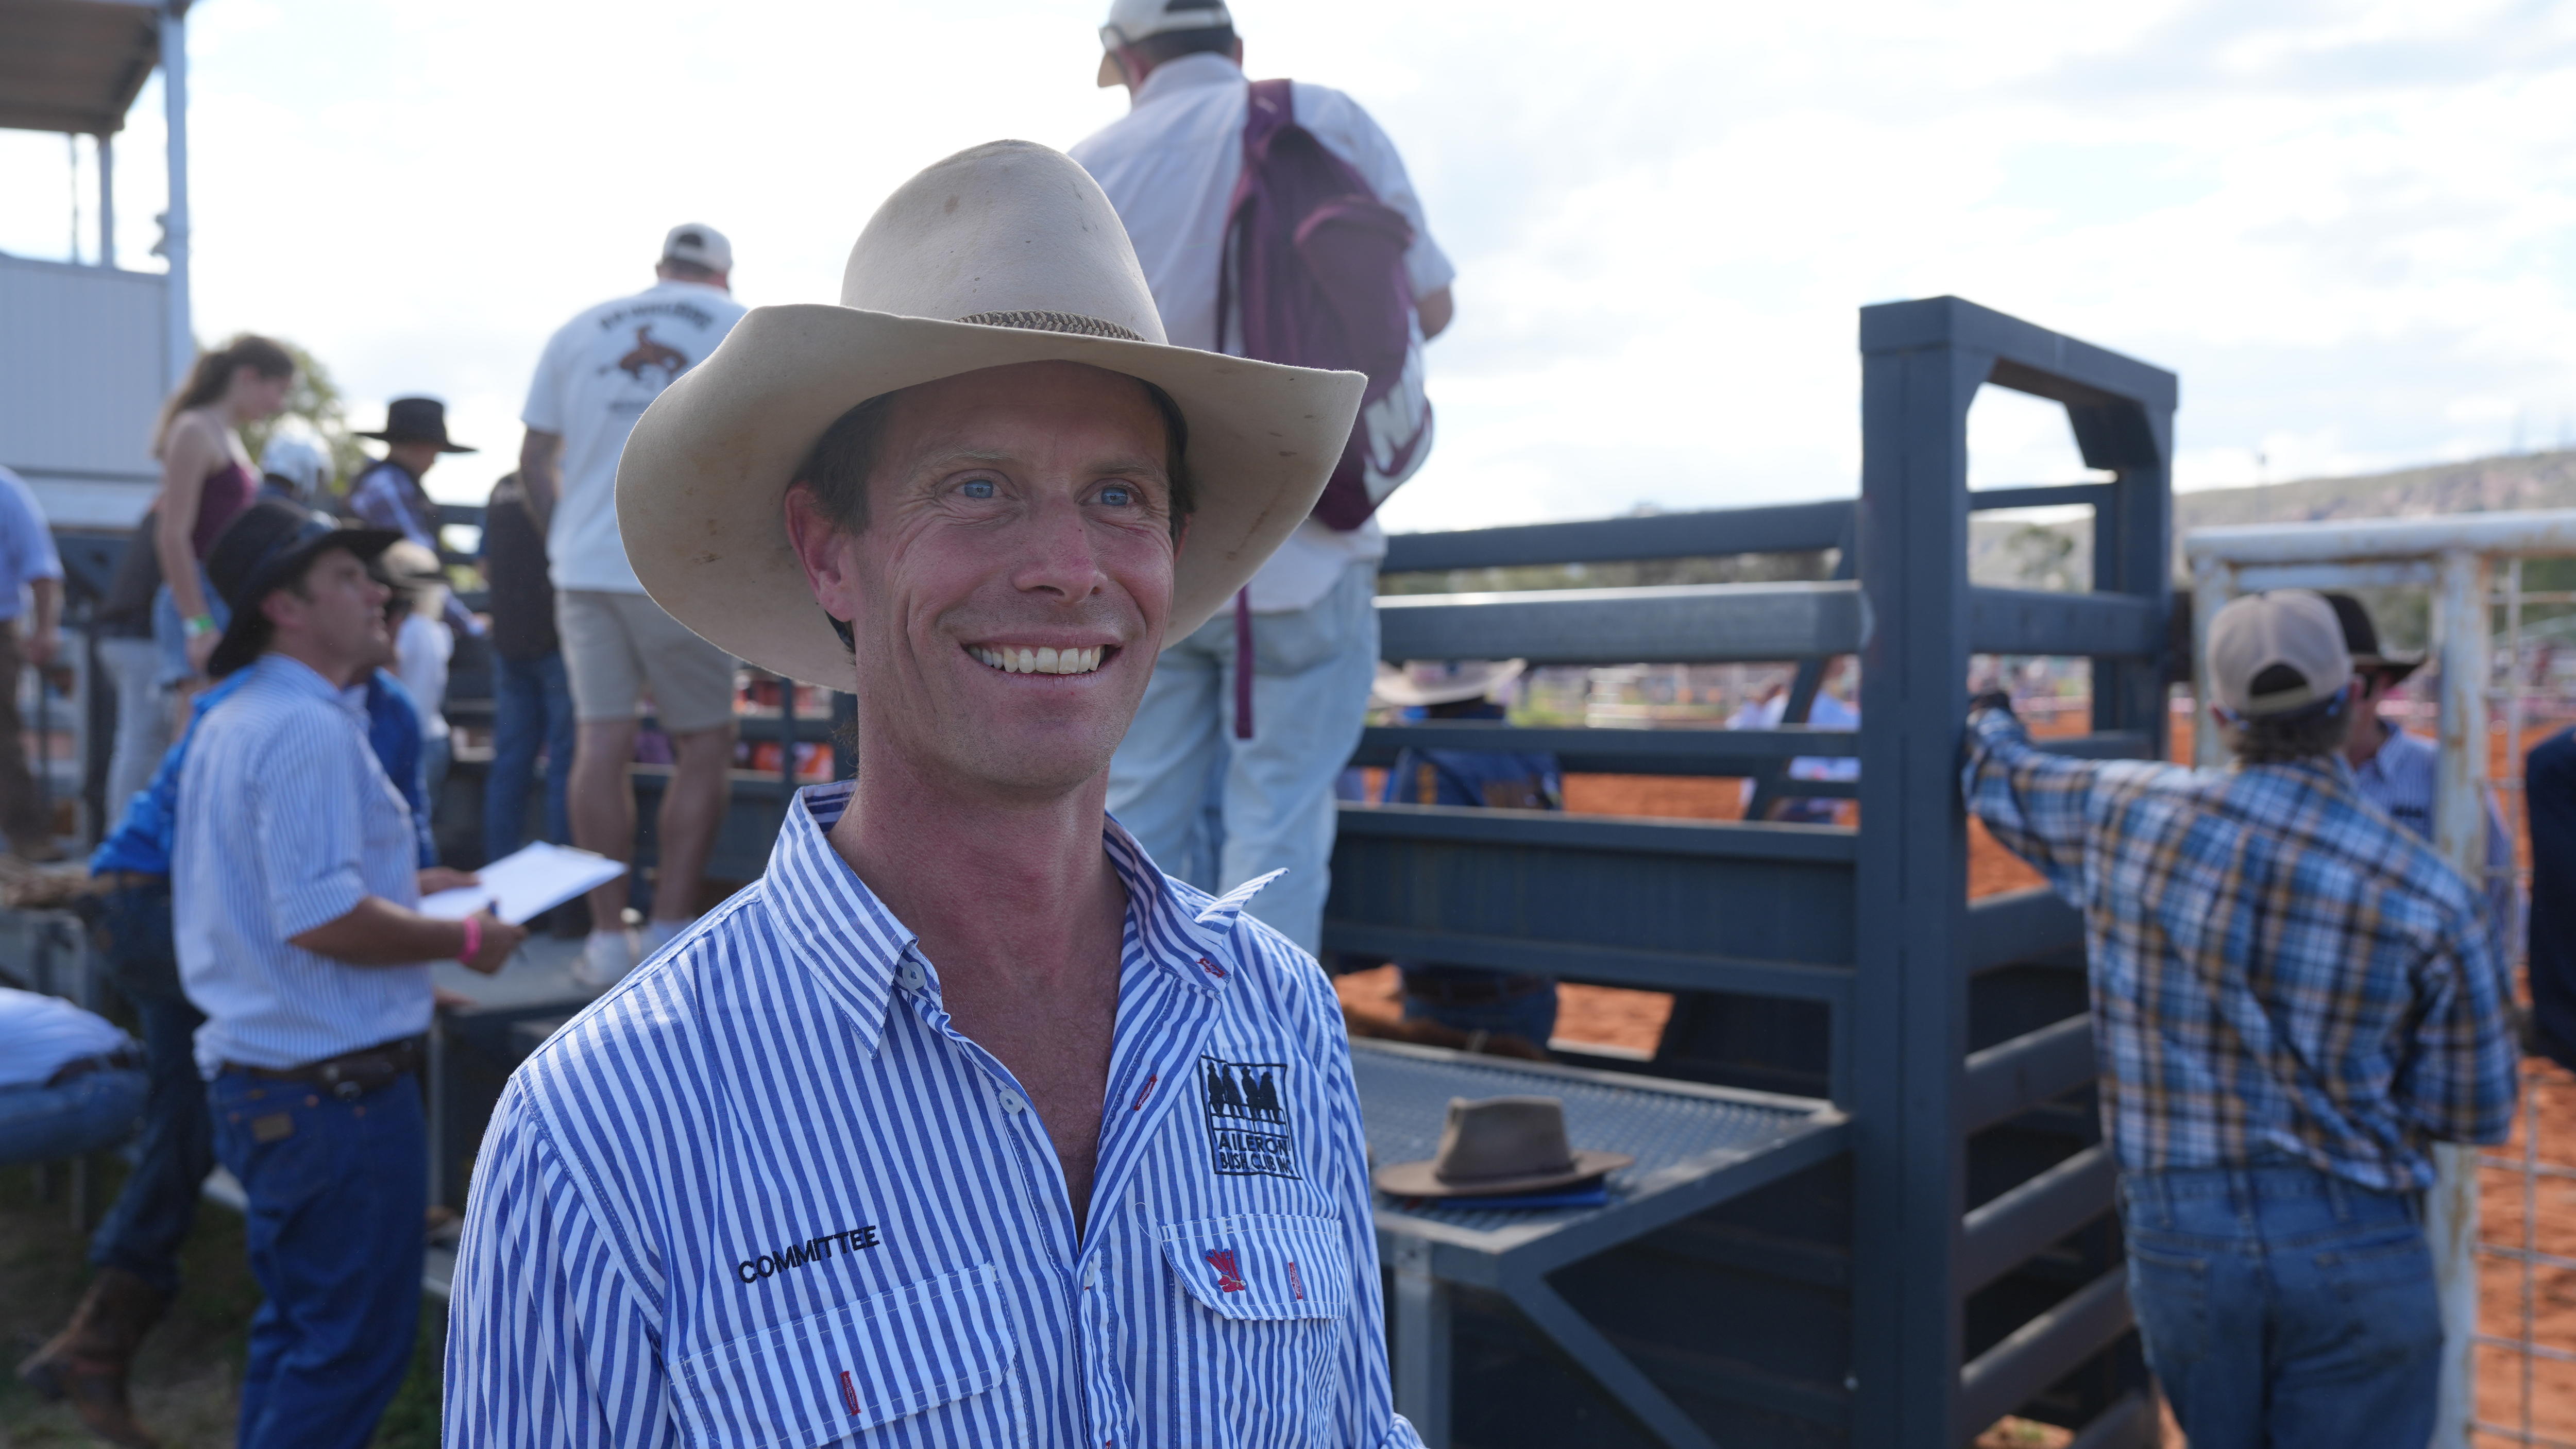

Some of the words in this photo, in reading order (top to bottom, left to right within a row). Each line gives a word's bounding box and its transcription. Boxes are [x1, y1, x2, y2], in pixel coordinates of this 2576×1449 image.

[1219, 1133, 1289, 1156] AILERON
[1220, 1152, 1249, 1170] BUSH
[1251, 1153, 1276, 1171] CLUB
[1277, 1156, 1294, 1174] INC
[738, 1225, 880, 1283] COMMITTEE
